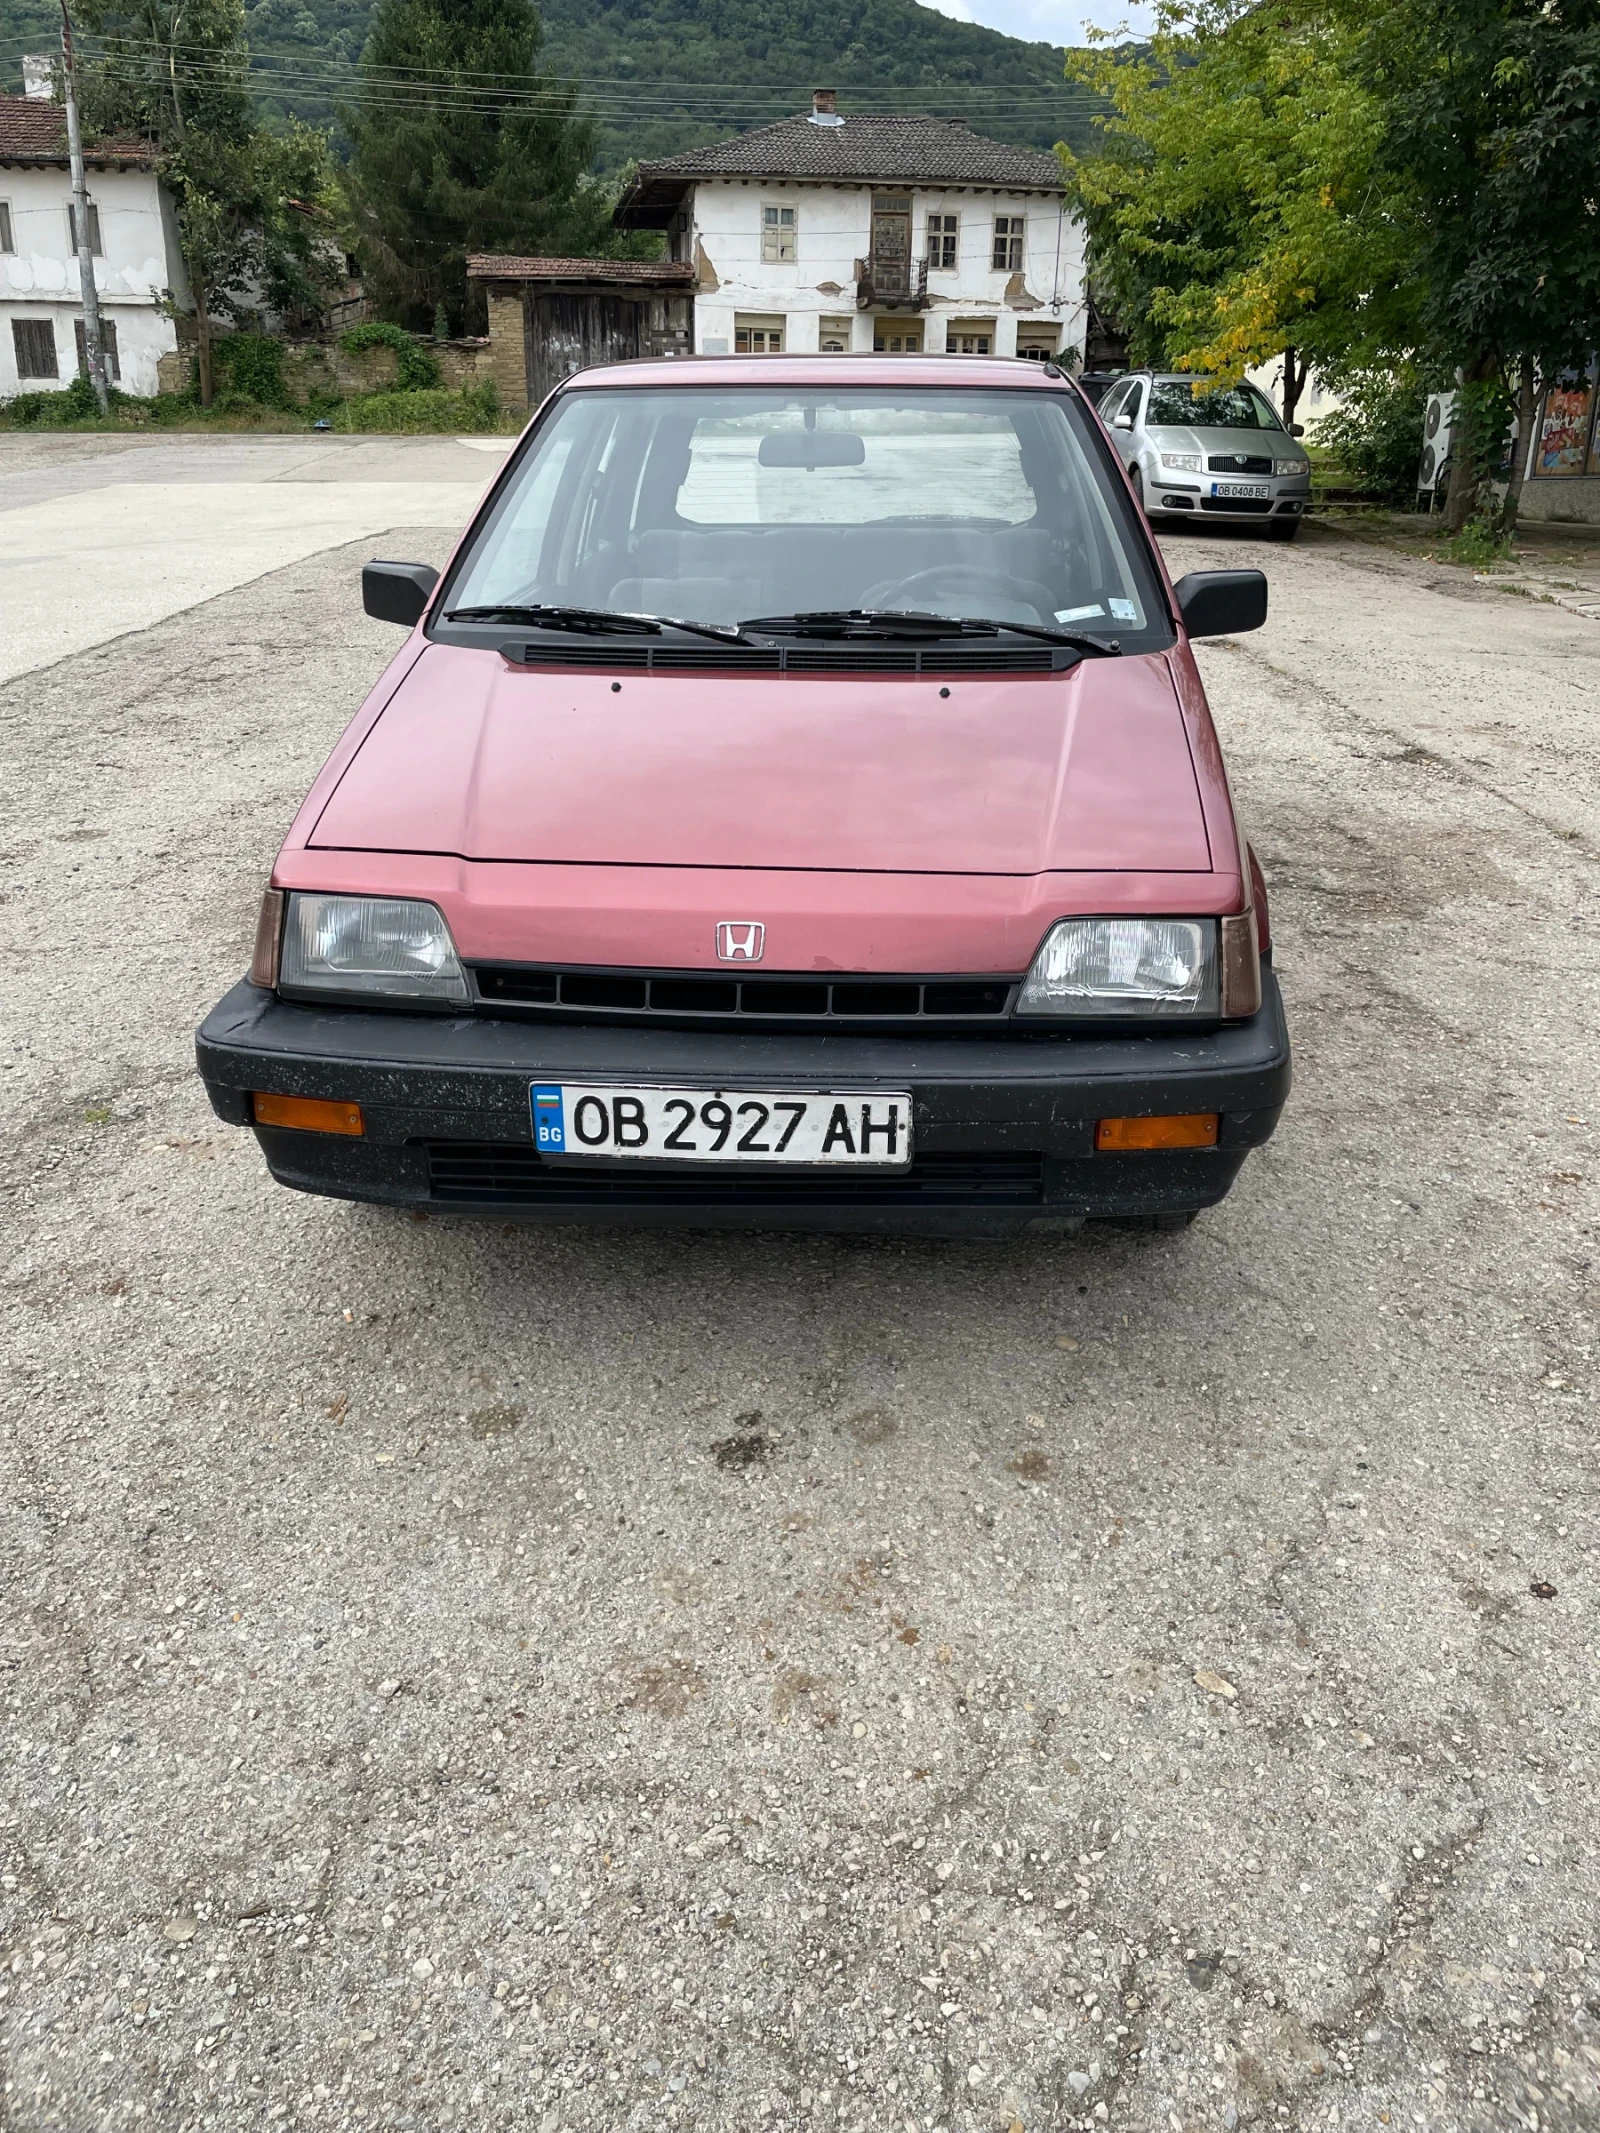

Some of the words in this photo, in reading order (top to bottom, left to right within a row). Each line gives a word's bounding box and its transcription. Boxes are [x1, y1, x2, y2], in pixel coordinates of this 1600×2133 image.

[1218, 486, 1230, 496] OB
[1232, 486, 1254, 497] 0408
[1255, 487, 1268, 498] BE
[574, 1095, 648, 1147] OB
[663, 1099, 806, 1152] 2927
[821, 1103, 898, 1154] AH
[539, 1126, 562, 1142] BG
